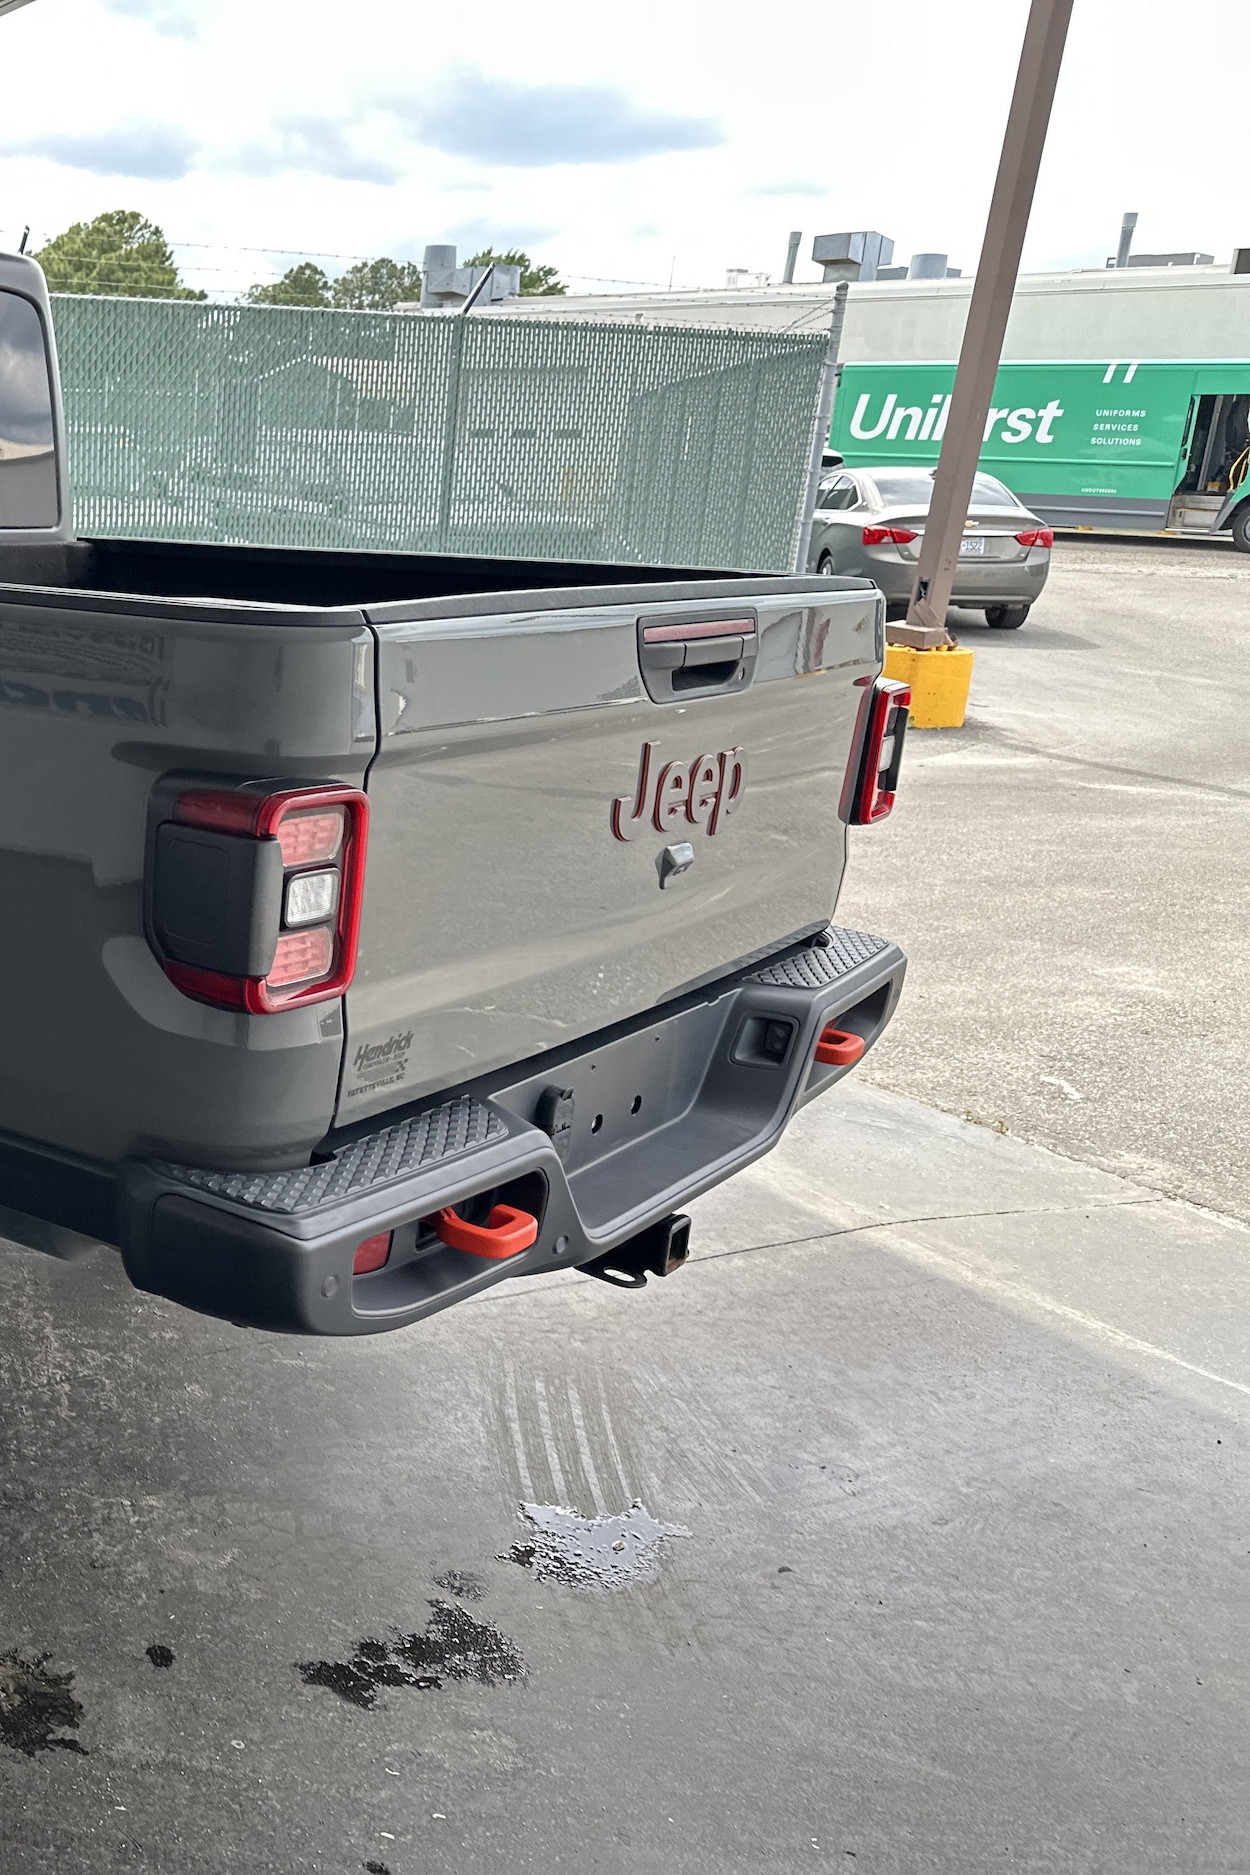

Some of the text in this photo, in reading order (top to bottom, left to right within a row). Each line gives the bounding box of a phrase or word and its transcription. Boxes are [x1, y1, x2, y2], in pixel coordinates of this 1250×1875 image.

[850, 393, 1064, 444] Unirst
[1095, 408, 1147, 418] UNIFORMS
[1092, 423, 1139, 432] SERVICES
[1090, 437, 1142, 446] SOLUTIONS
[610, 740, 749, 841] Jeep
[353, 1030, 414, 1071] Hendrick
